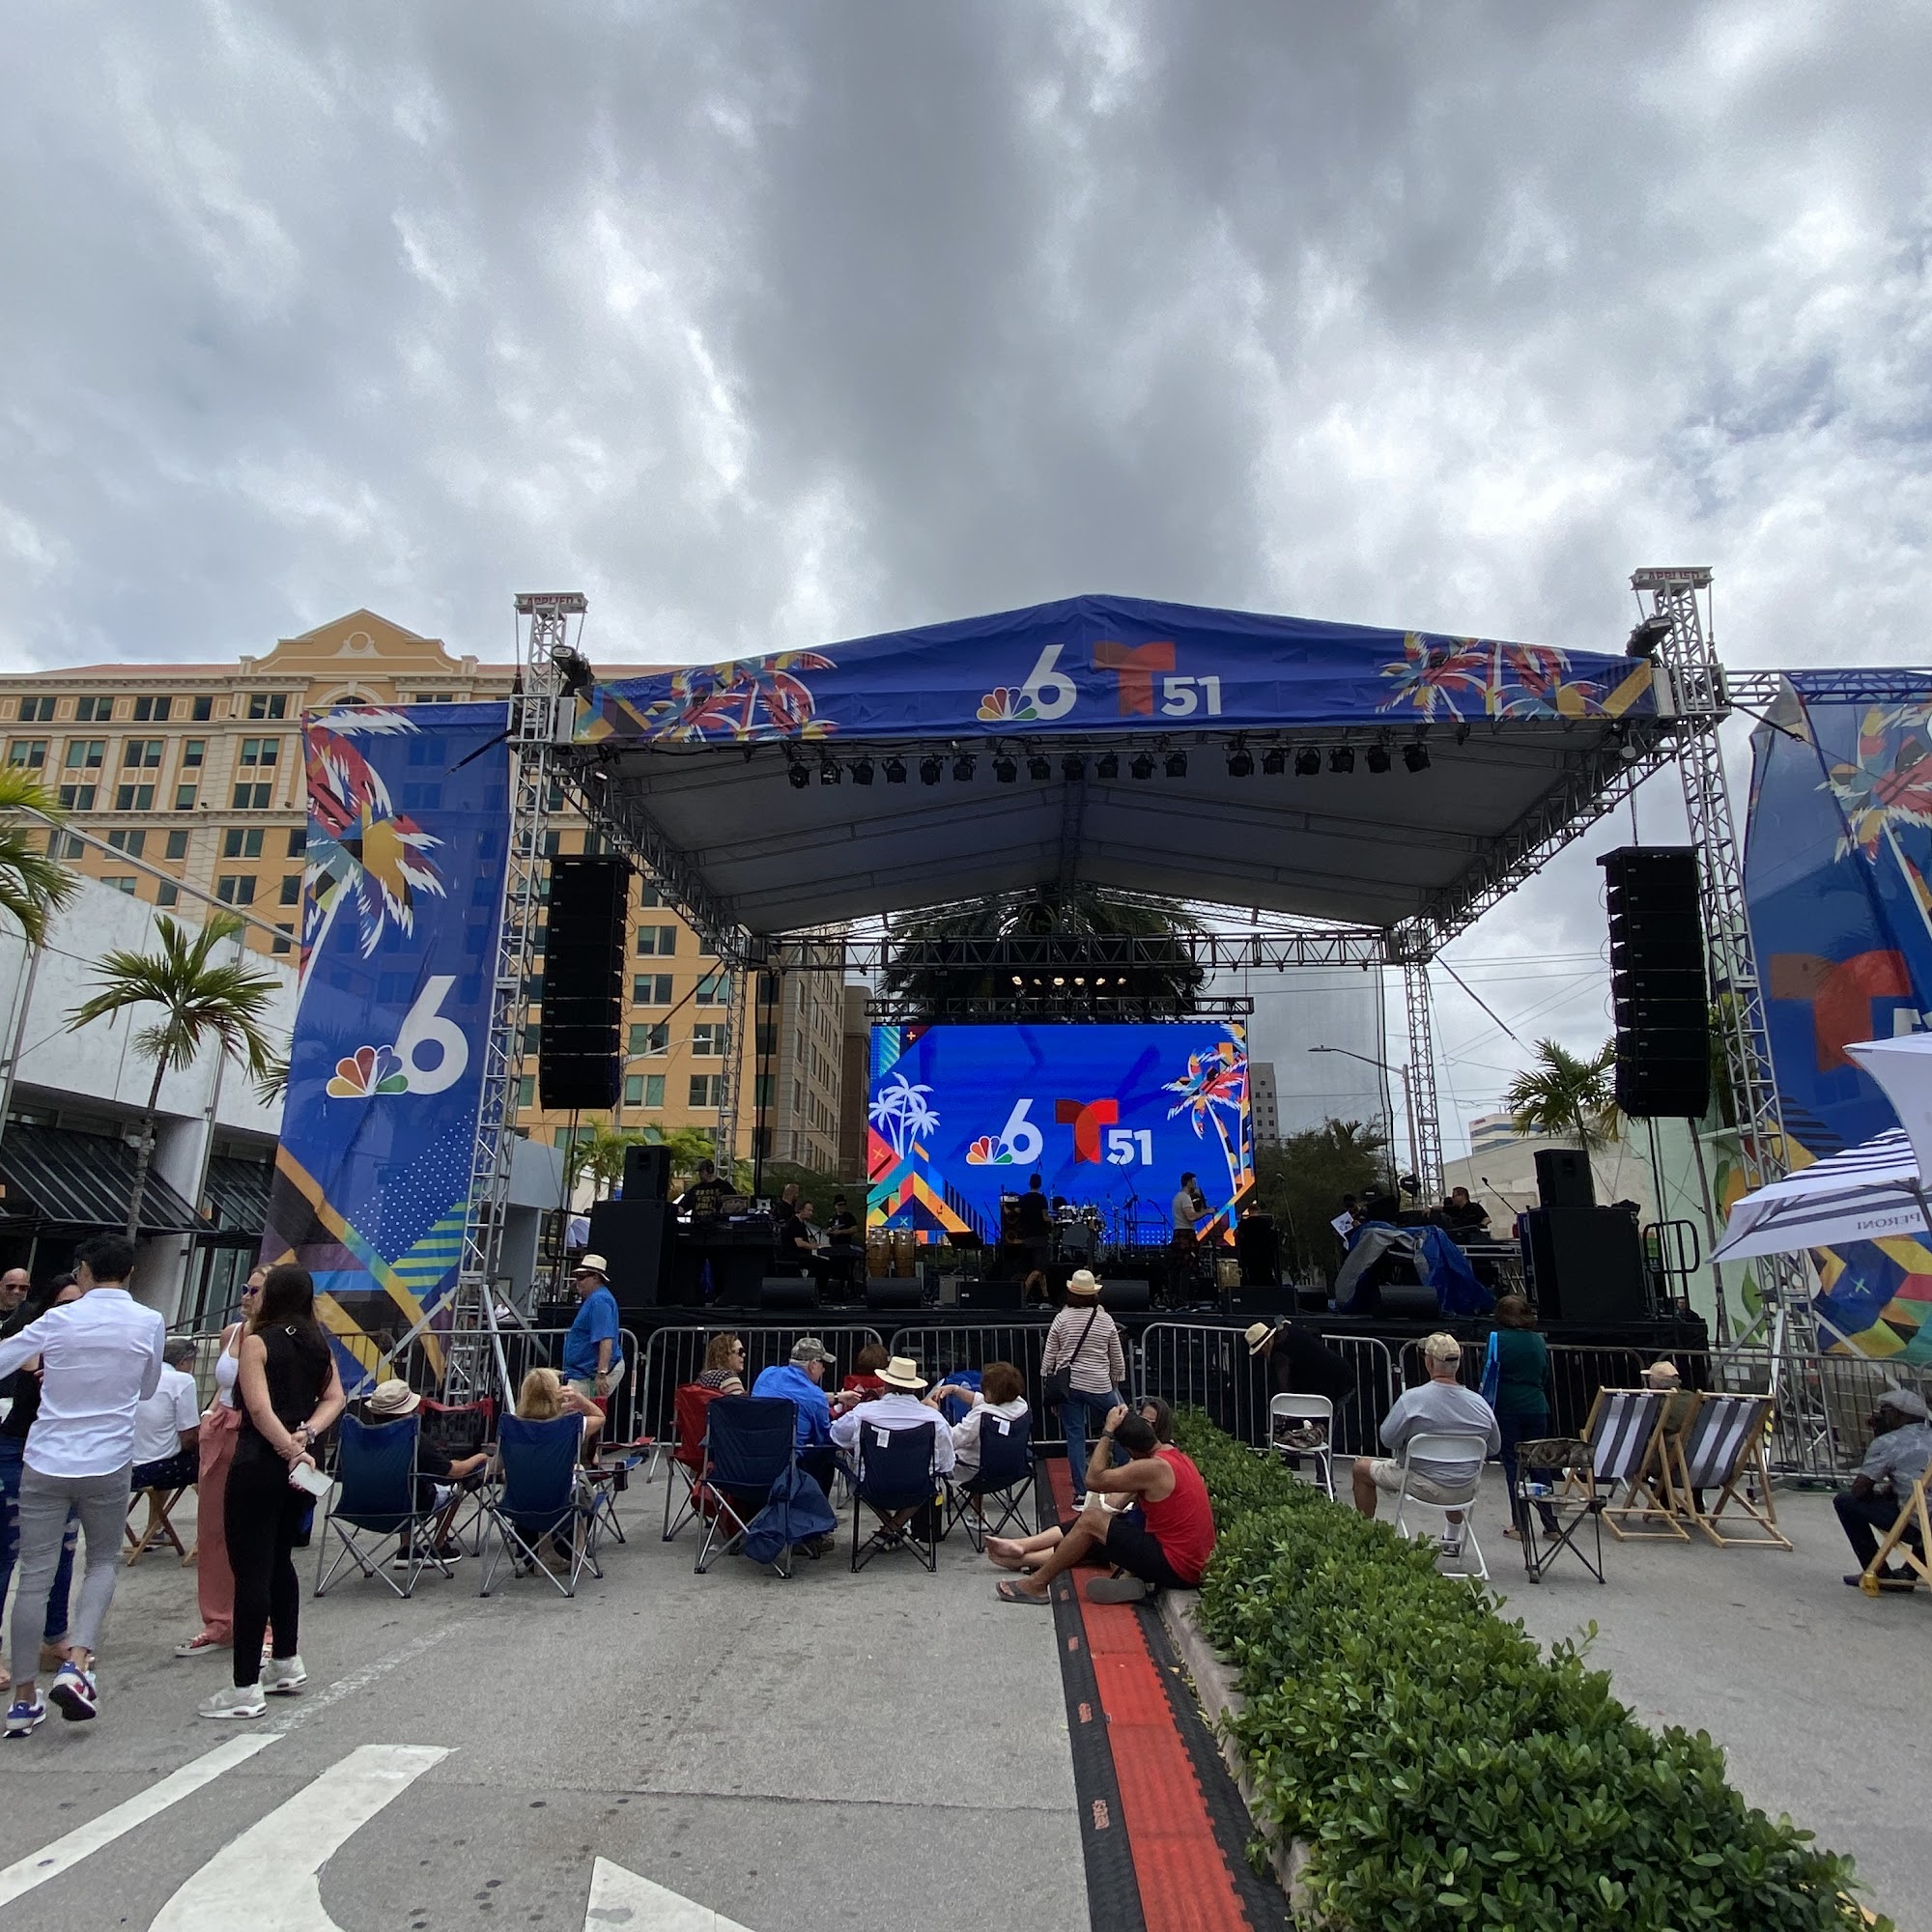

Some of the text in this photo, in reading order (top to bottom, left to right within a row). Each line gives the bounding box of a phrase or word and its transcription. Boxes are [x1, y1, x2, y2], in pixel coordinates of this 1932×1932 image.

[1022, 643, 1077, 721] 6
[1160, 675, 1222, 717] 51
[393, 975, 469, 1095] 6
[1000, 1098, 1044, 1165] 6
[1106, 1129, 1153, 1166] 51
